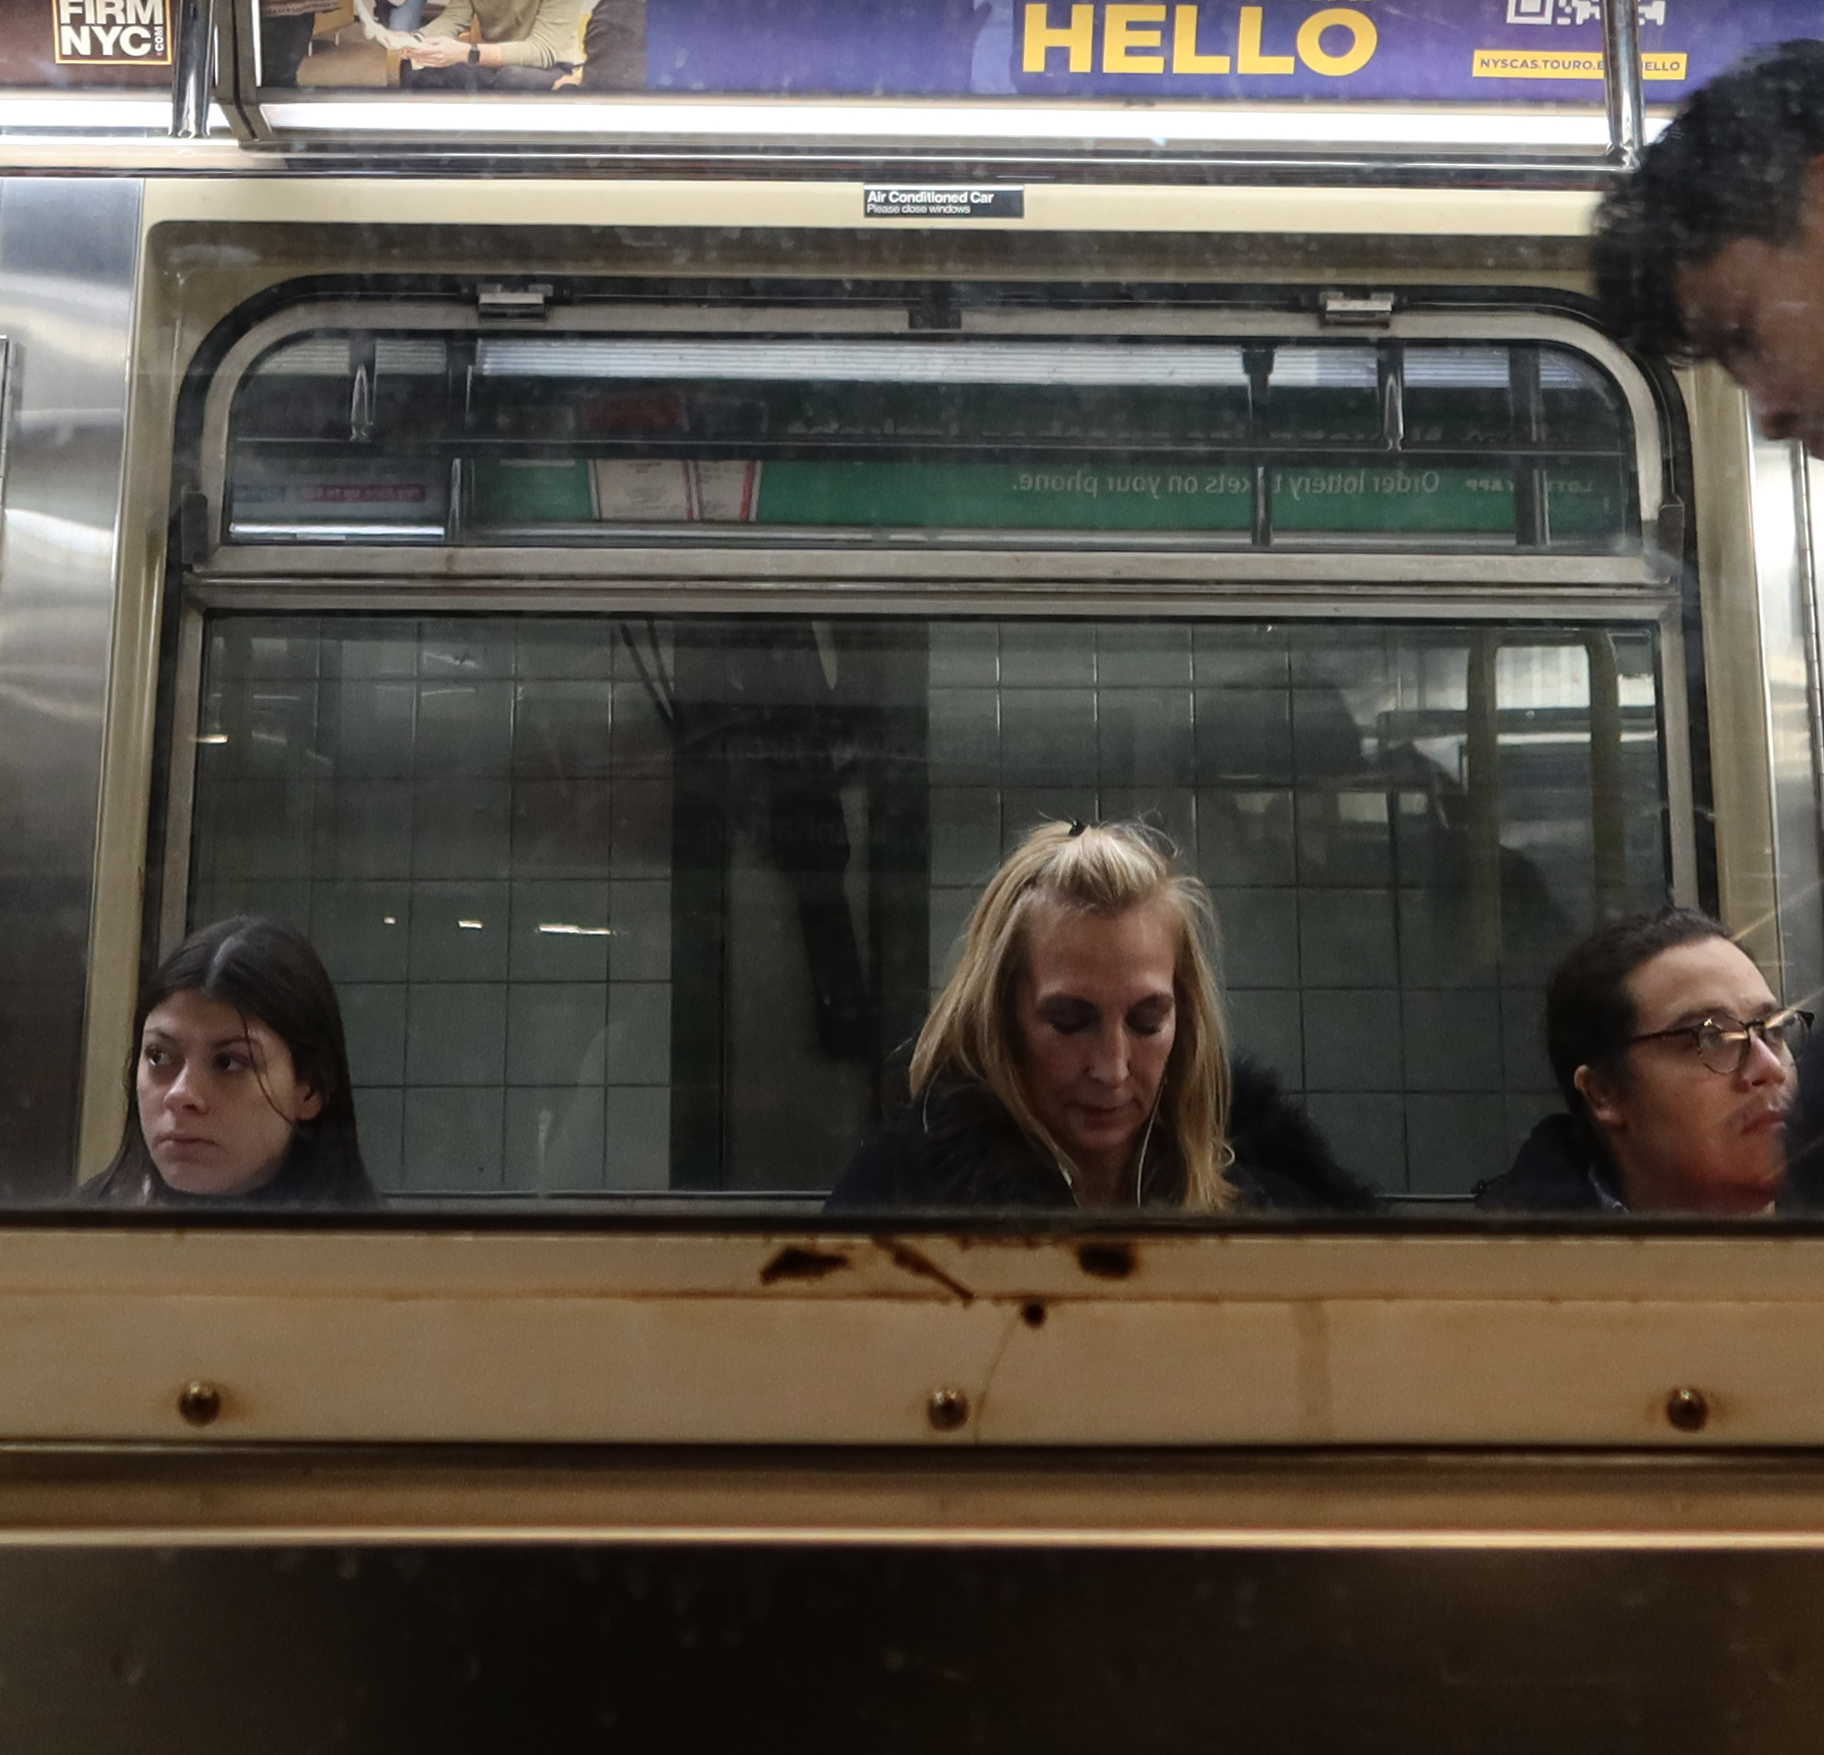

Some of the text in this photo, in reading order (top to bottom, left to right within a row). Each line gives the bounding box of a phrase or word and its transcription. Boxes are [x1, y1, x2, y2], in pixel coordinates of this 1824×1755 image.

[61, 25, 152, 56] NYC
[1022, 3, 1378, 77] HELLO
[867, 190, 994, 204] Air Conditioned Car
[867, 204, 971, 214] Please close windows
